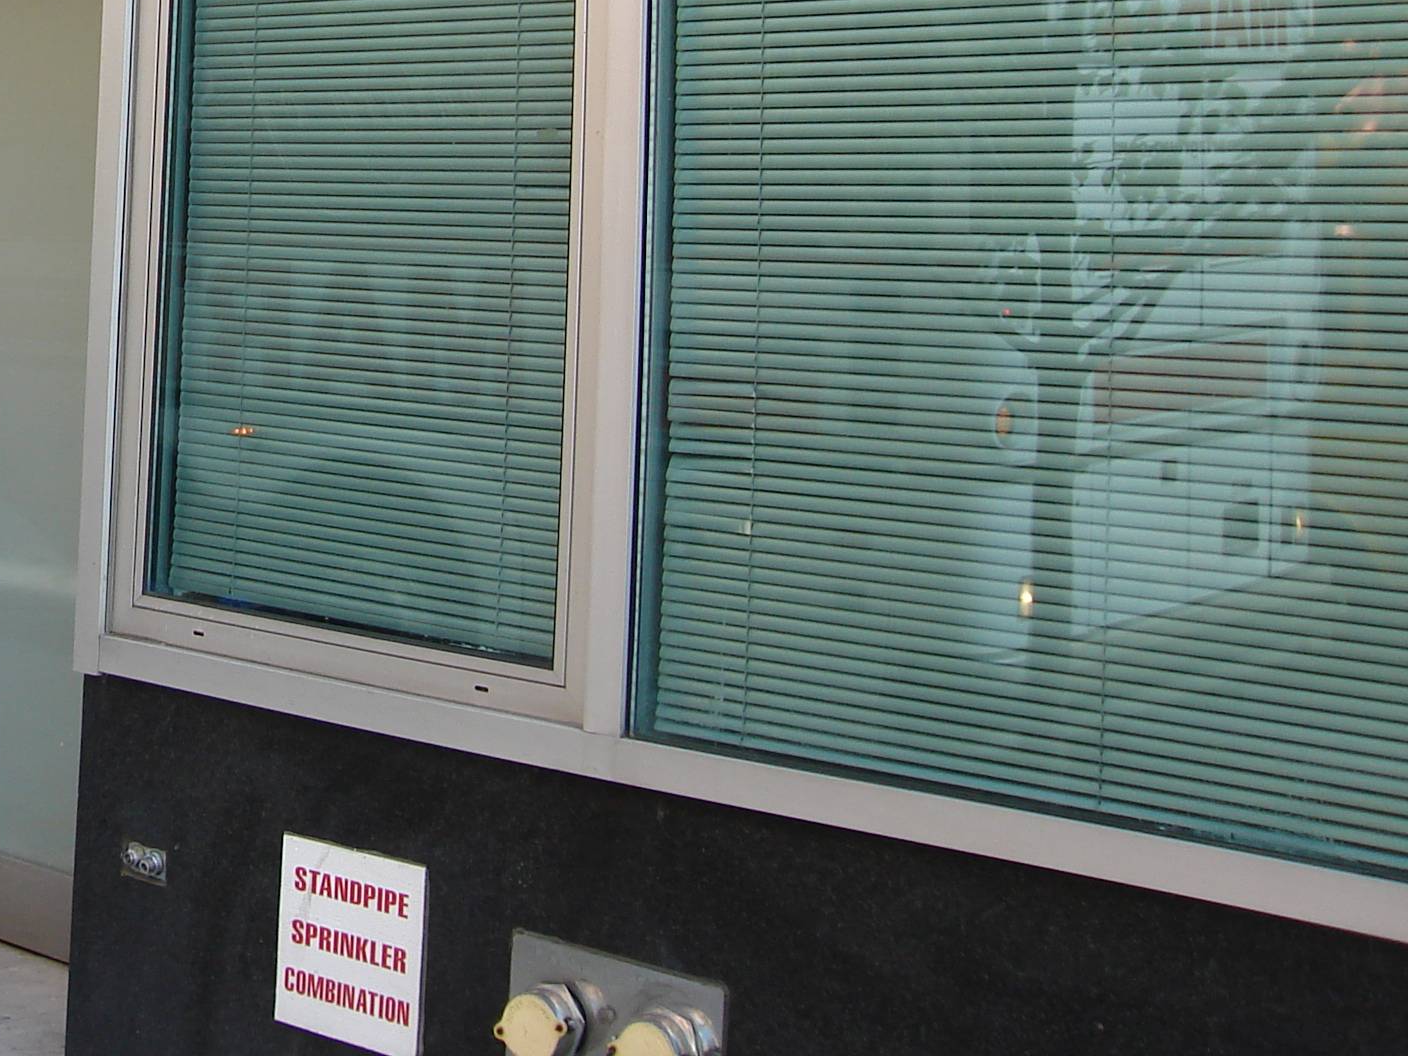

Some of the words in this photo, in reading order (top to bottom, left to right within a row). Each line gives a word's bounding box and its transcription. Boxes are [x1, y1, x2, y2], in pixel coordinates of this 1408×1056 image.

[294, 866, 409, 919] STANDPIPE
[291, 919, 407, 974] SPRINKLER
[284, 966, 410, 1027] COMBINATION
